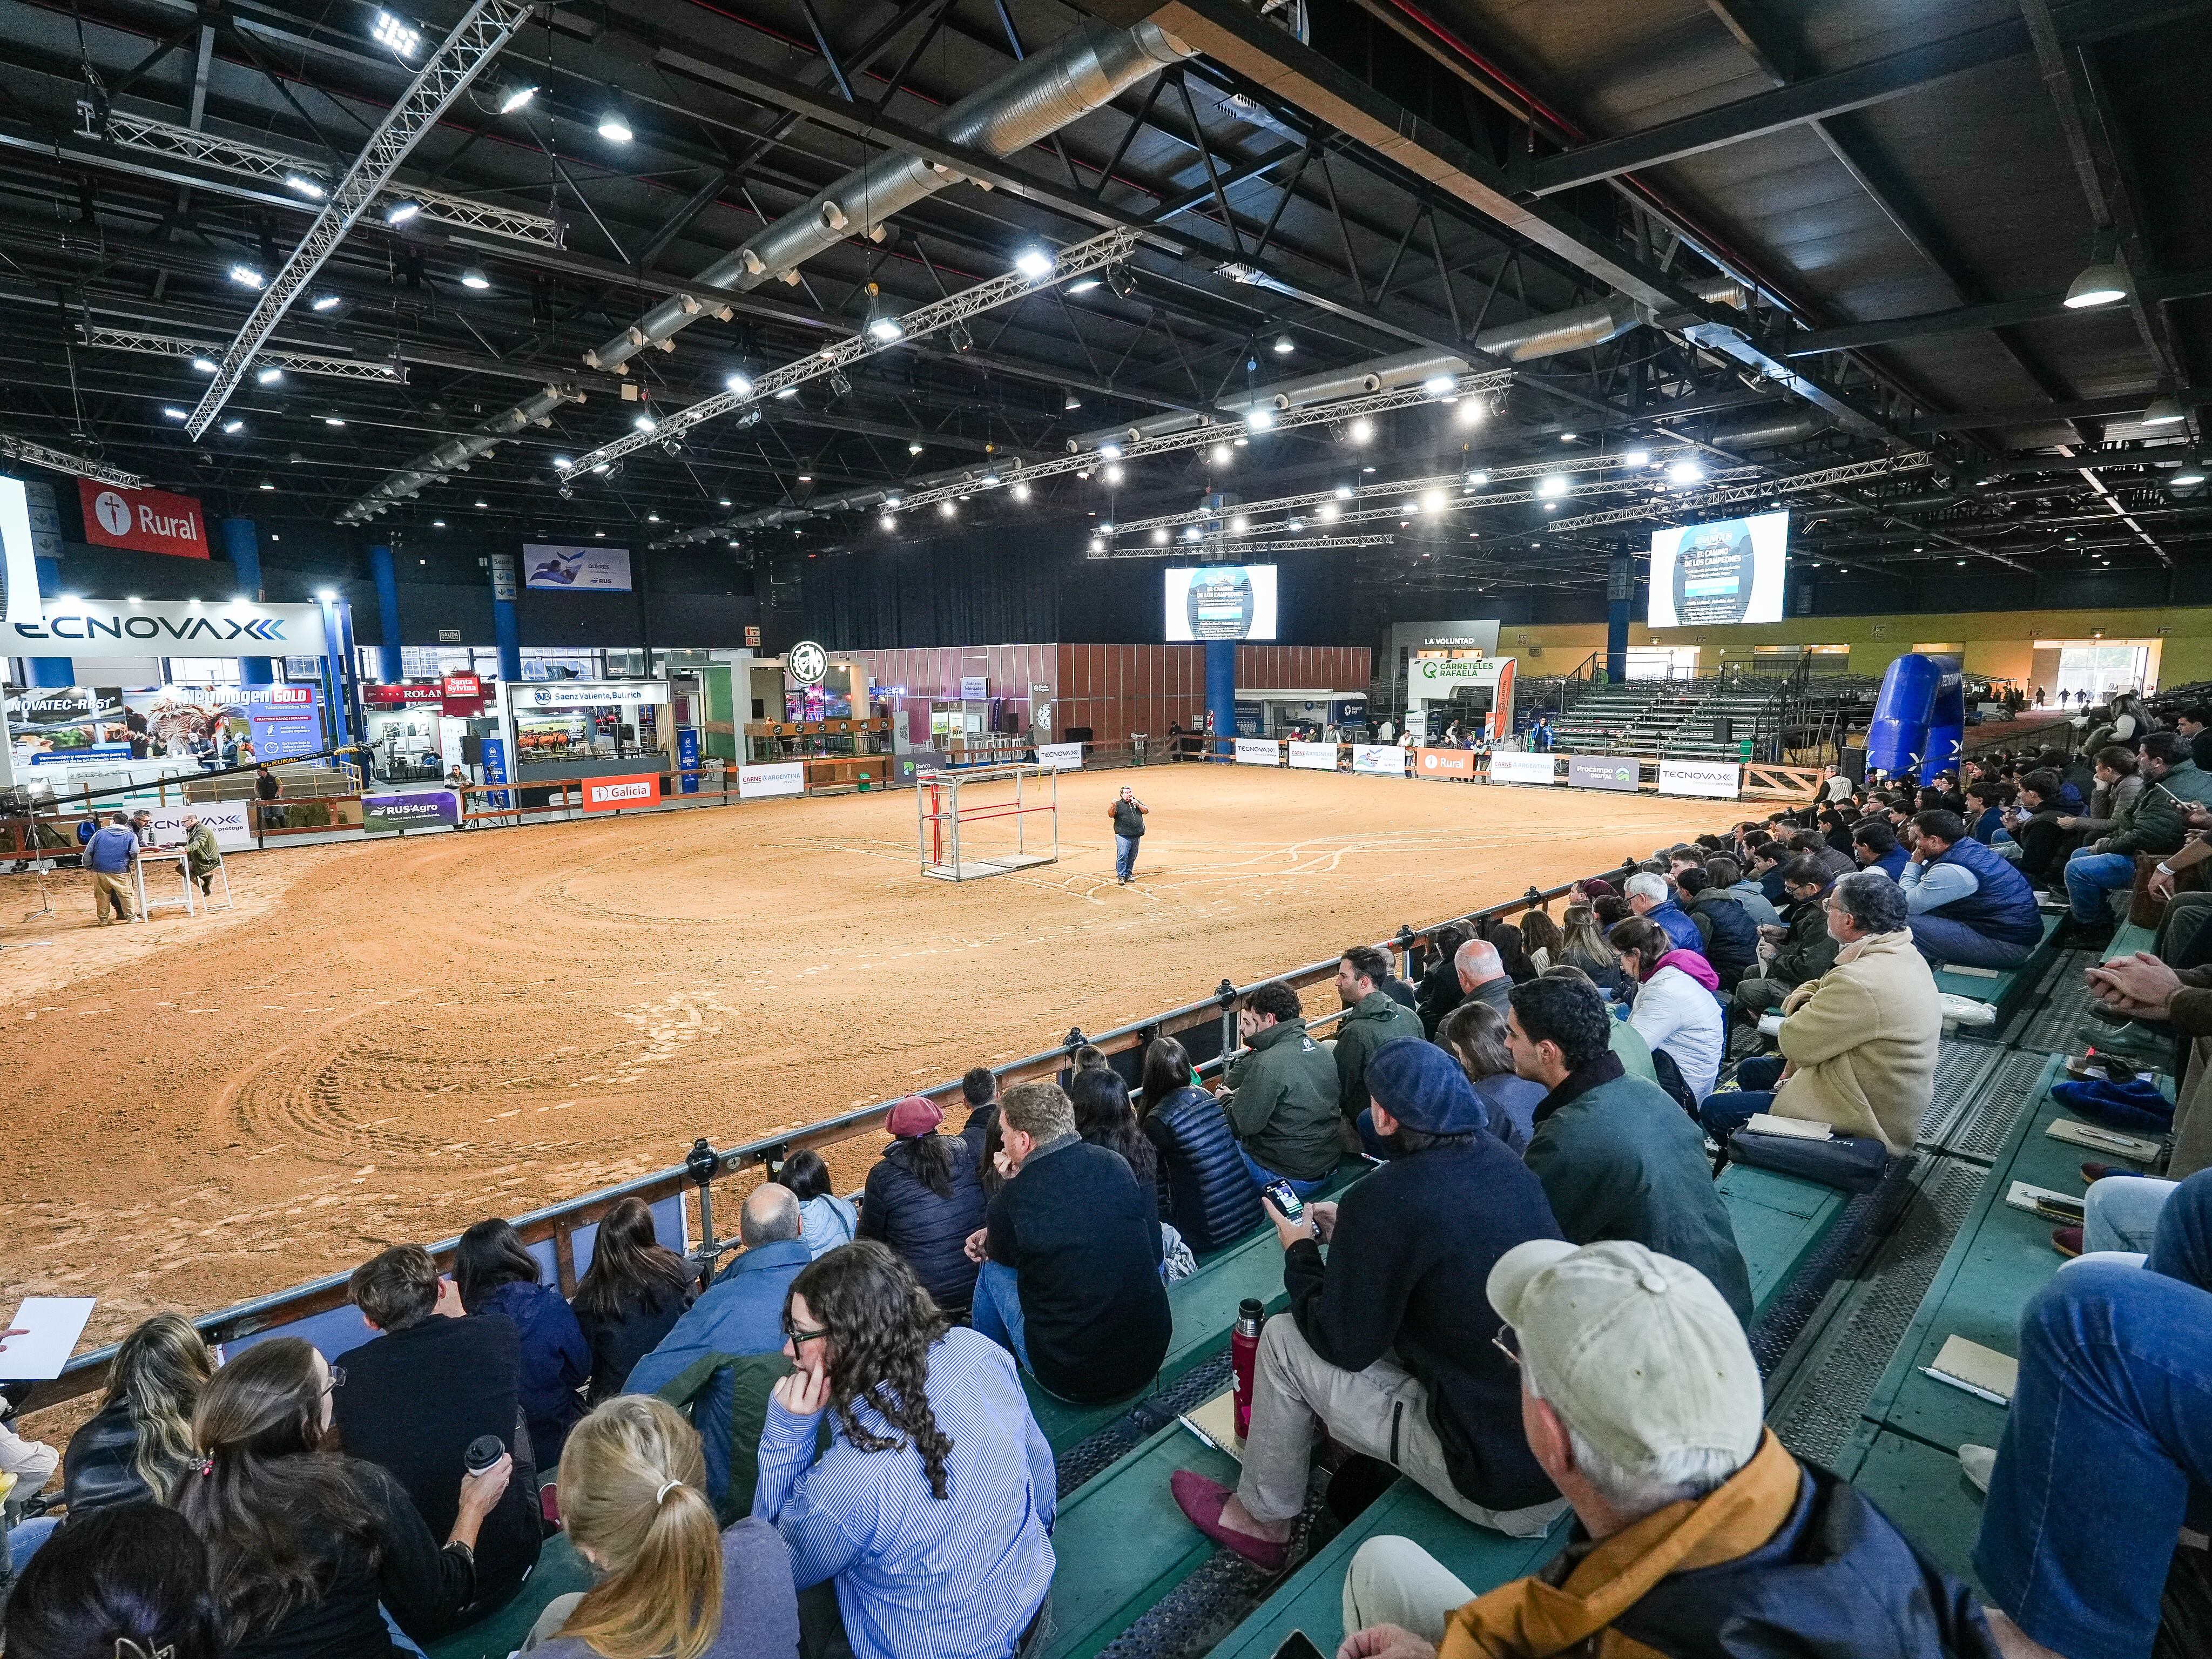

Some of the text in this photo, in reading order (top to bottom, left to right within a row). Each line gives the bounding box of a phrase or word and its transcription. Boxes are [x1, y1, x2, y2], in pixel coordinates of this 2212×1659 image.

[138, 504, 198, 541] Rural
[1704, 548, 1729, 557] CAMINO
[1704, 554, 1742, 565] CAMPEONES
[15, 616, 286, 640] ECNOVAX
[184, 690, 307, 706] Neumogen GOLD
[1041, 750, 1080, 758] TECNOVAX
[1440, 757, 1464, 769] Rural
[1577, 765, 1614, 774] Procampo
[1663, 771, 1734, 781] TECNOVAX
[611, 785, 646, 797] Galicia
